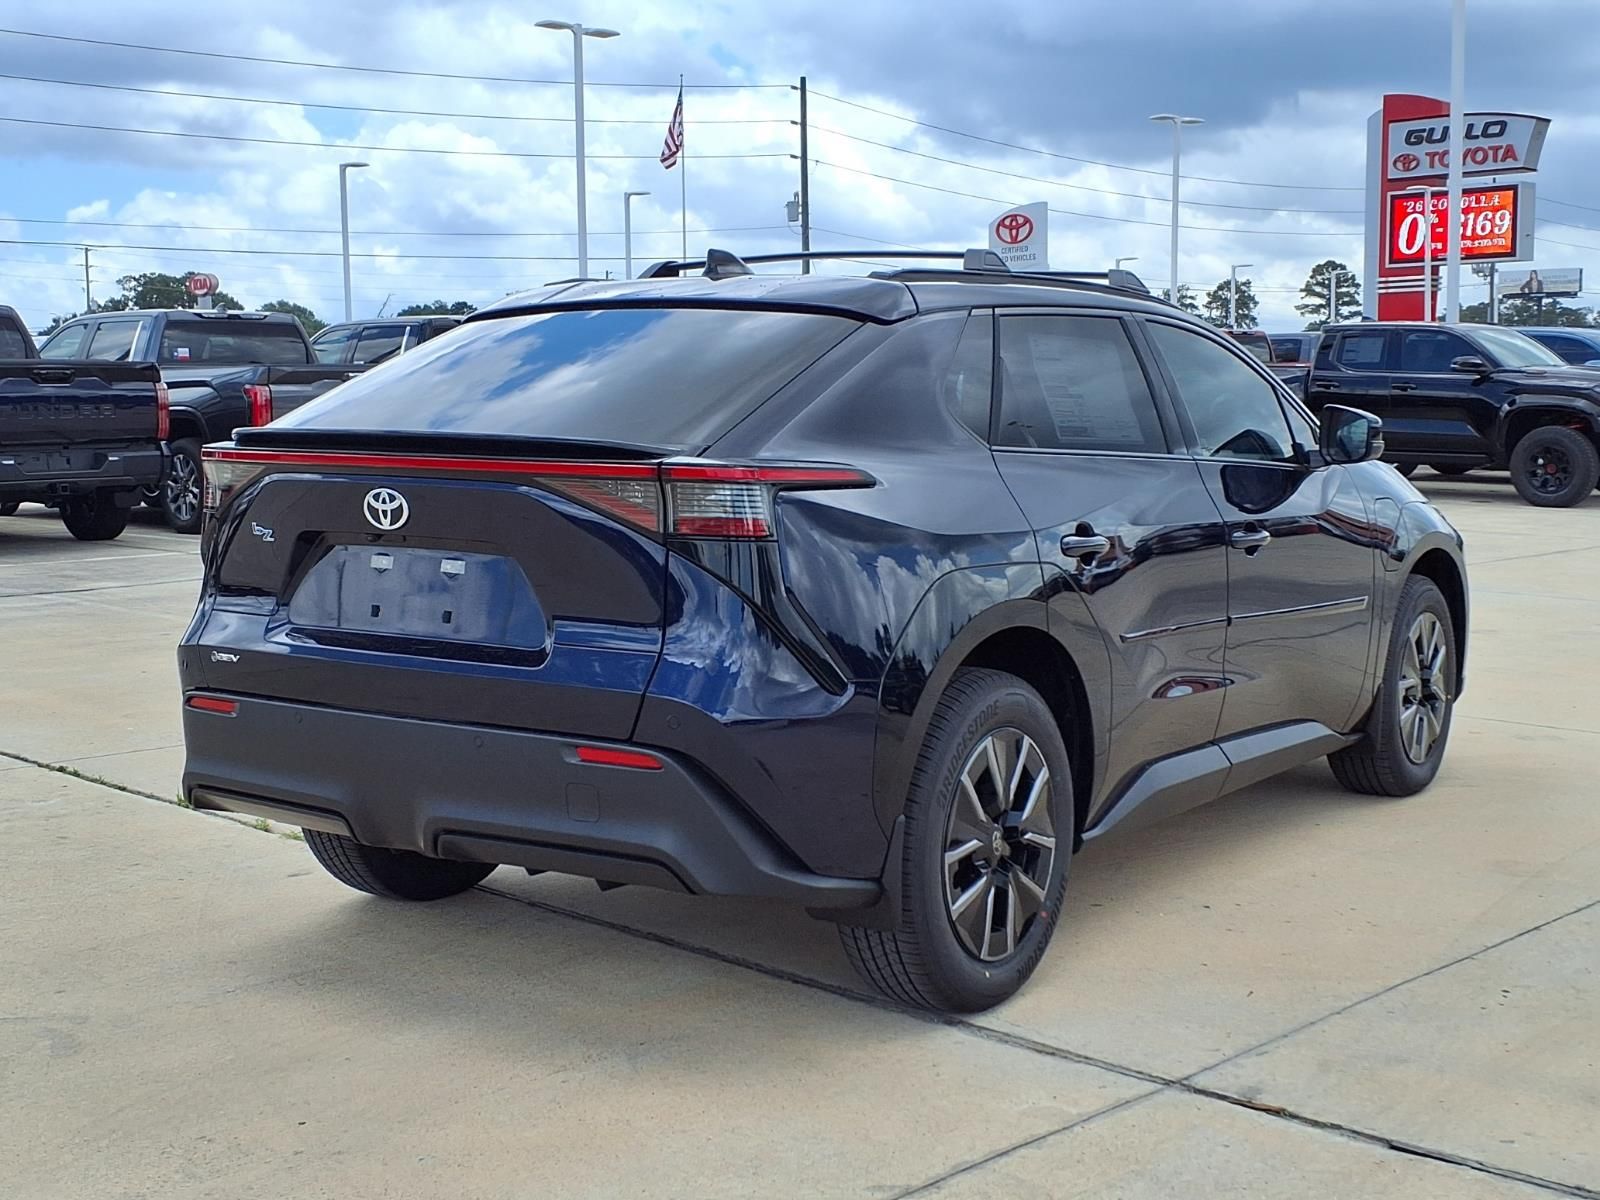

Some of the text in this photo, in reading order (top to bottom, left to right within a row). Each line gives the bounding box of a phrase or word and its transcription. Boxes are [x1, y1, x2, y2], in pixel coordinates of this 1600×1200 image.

[1404, 120, 1508, 146] GULO
[1429, 194, 1501, 211] COOLLA
[1001, 246, 1028, 254] CERTIFIED
[1010, 253, 1036, 262] VEHICLES
